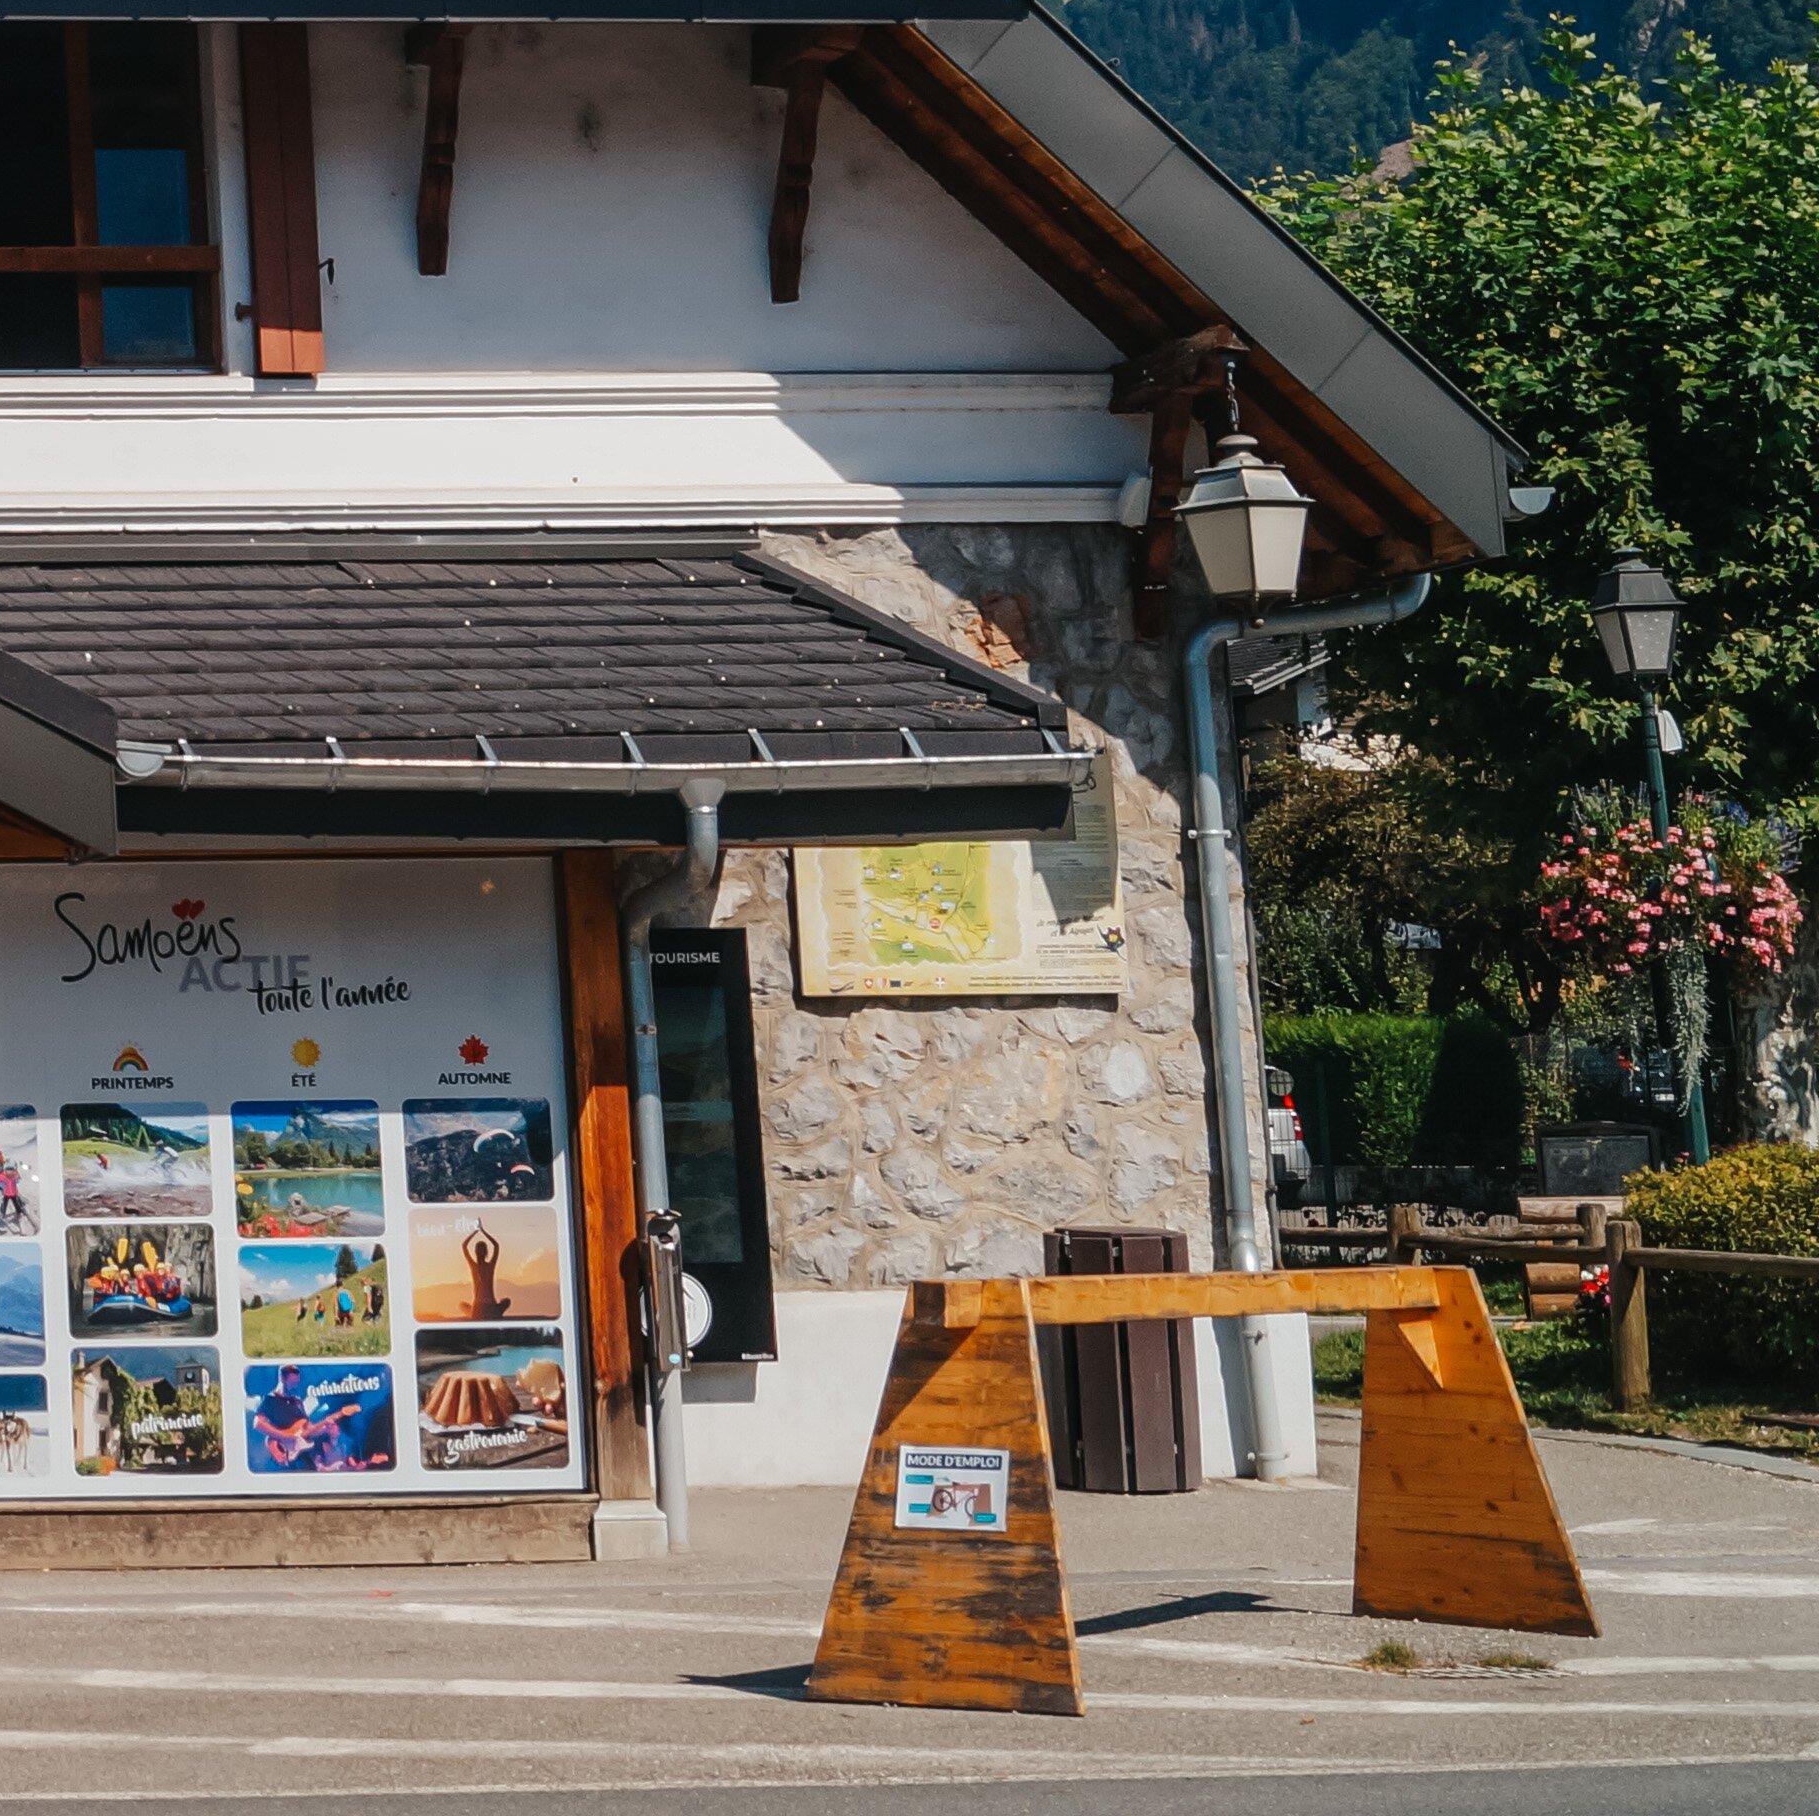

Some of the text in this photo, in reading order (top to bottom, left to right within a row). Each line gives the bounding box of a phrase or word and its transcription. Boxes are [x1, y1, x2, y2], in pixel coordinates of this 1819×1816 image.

[179, 954, 311, 993] ACTIF
[246, 976, 411, 1015] toute l'année
[91, 1077, 174, 1090] PRINTEMPS
[291, 1072, 317, 1088] ÉTÉ
[438, 1072, 512, 1085] AUTOMNE
[307, 1373, 380, 1397] animations
[132, 1413, 204, 1440] patrimoine
[444, 1428, 528, 1464] gastronomie
[907, 1454, 1000, 1468] MODE D'EMPLOI
